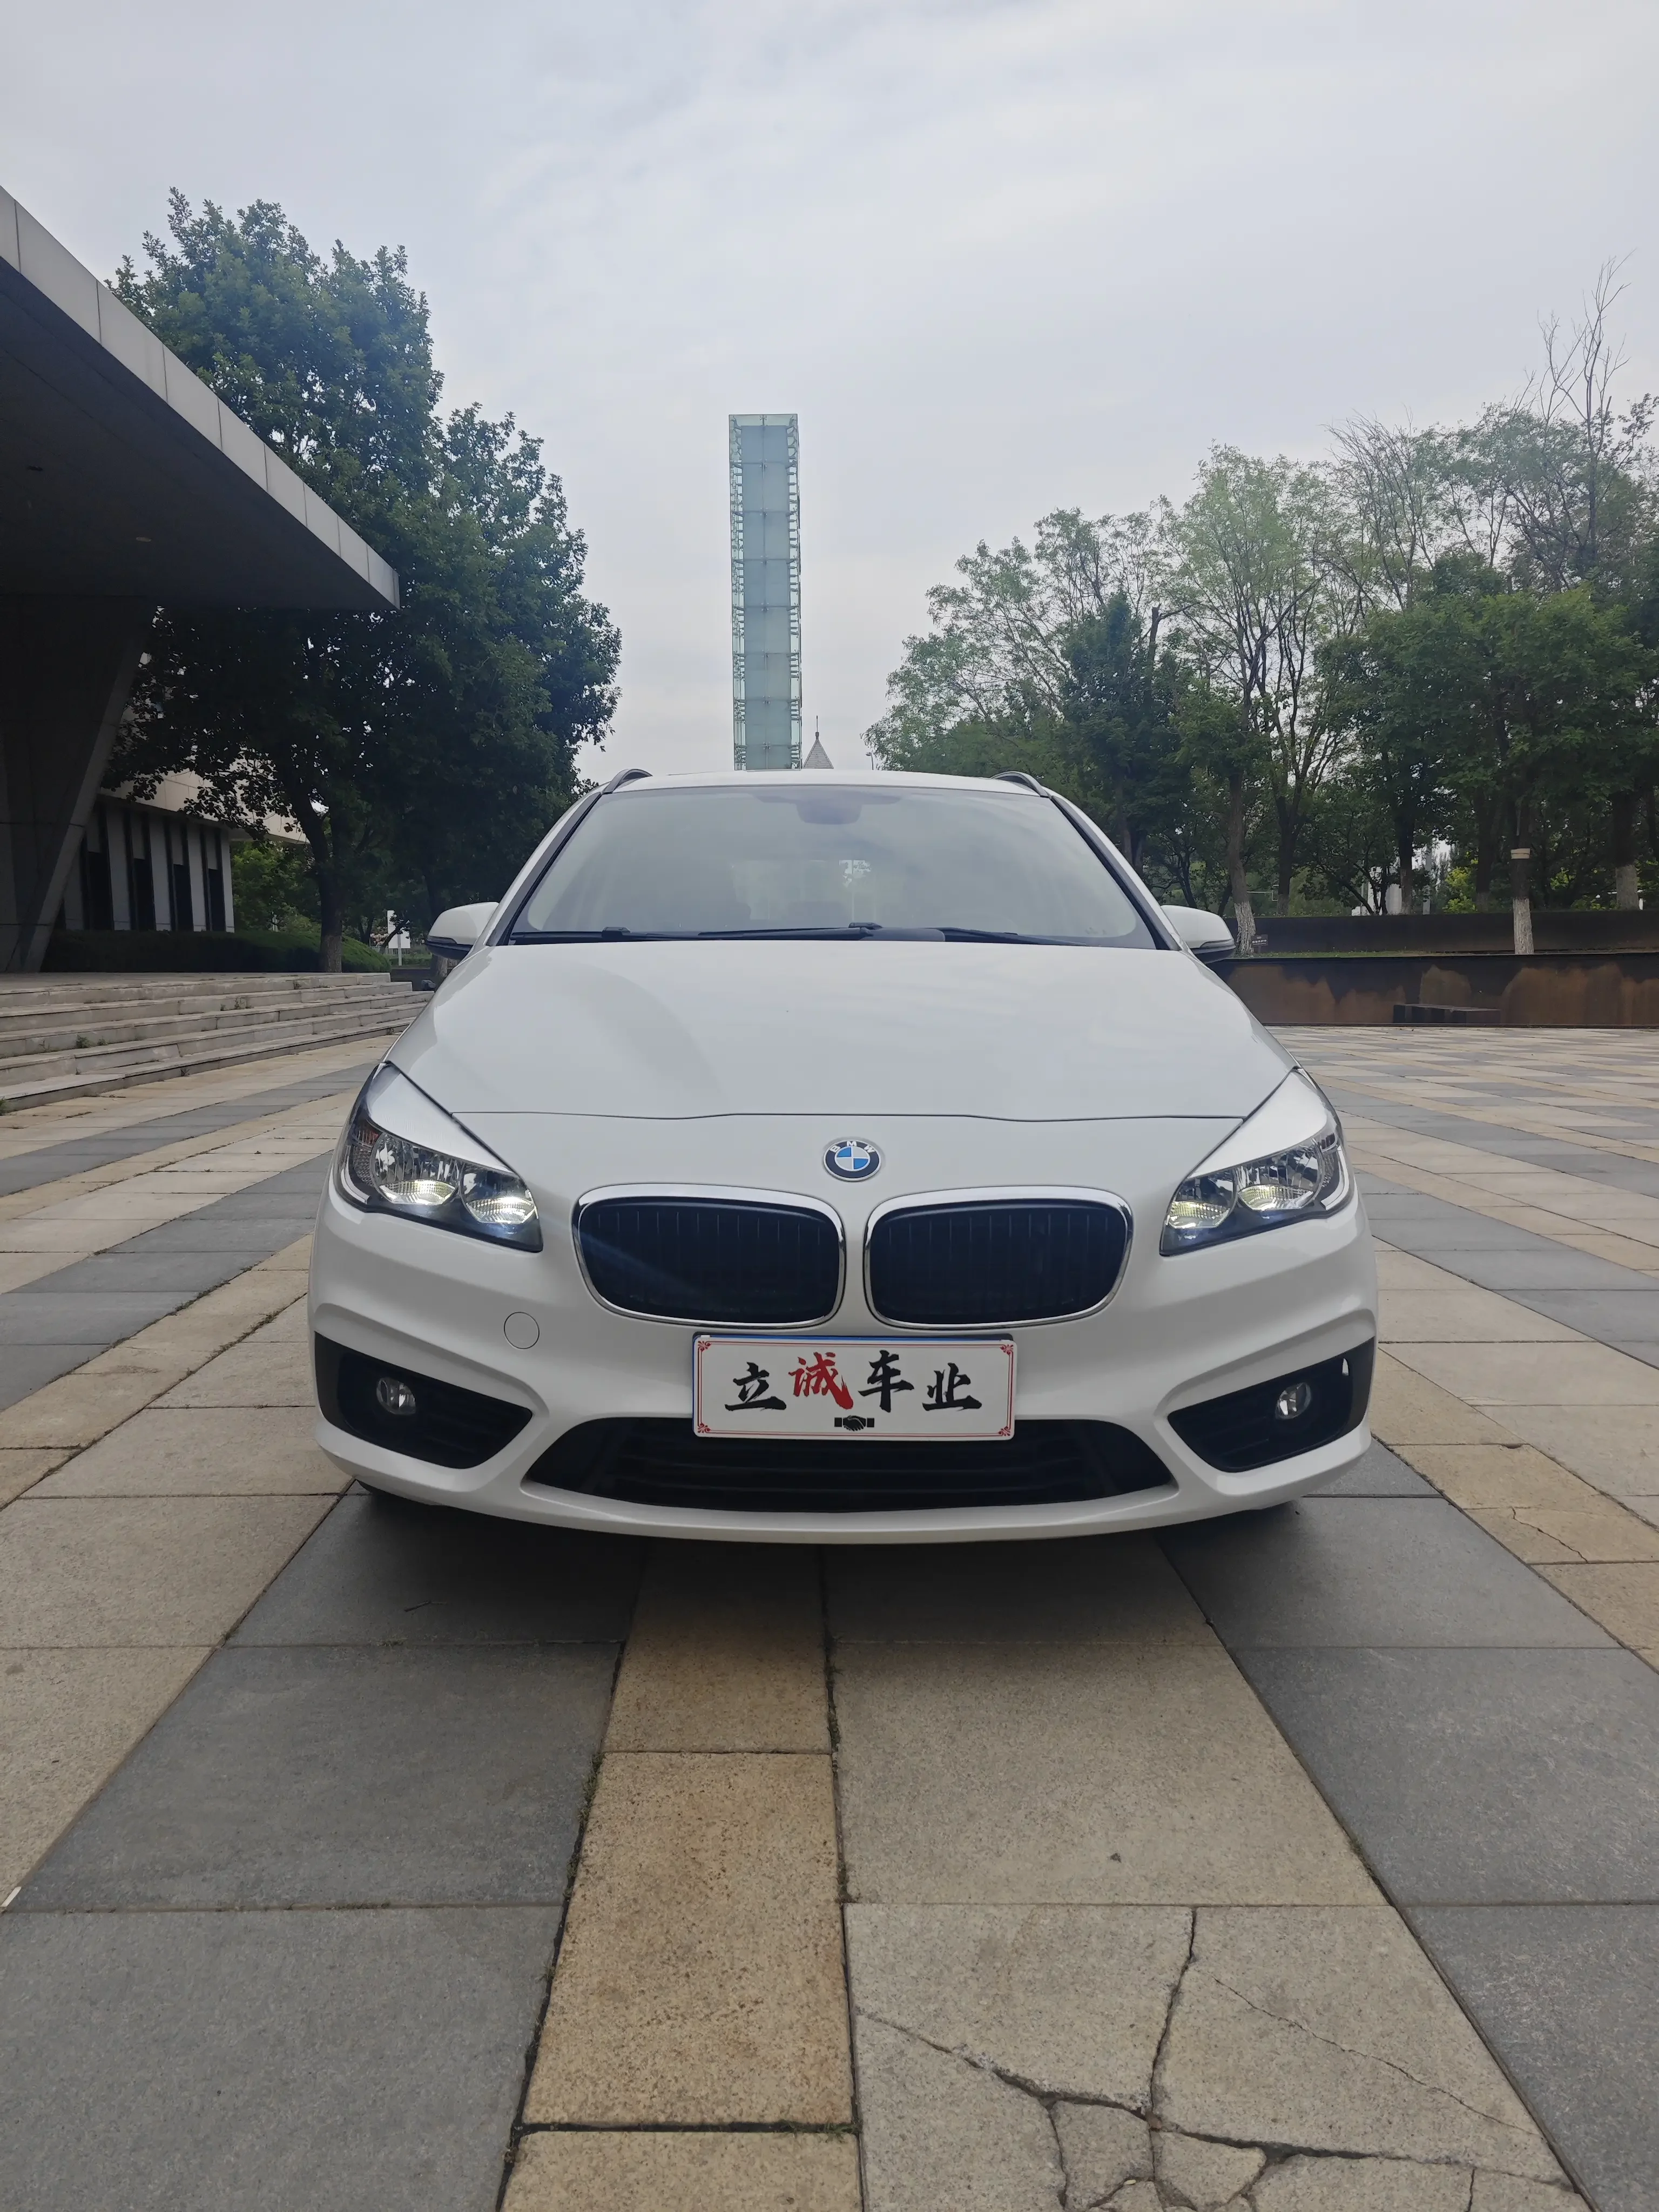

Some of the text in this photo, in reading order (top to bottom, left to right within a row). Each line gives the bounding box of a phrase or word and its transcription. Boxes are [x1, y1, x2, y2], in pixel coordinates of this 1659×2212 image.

[830, 1141, 875, 1153] BMW
[724, 1350, 982, 1413] 立诚车业
